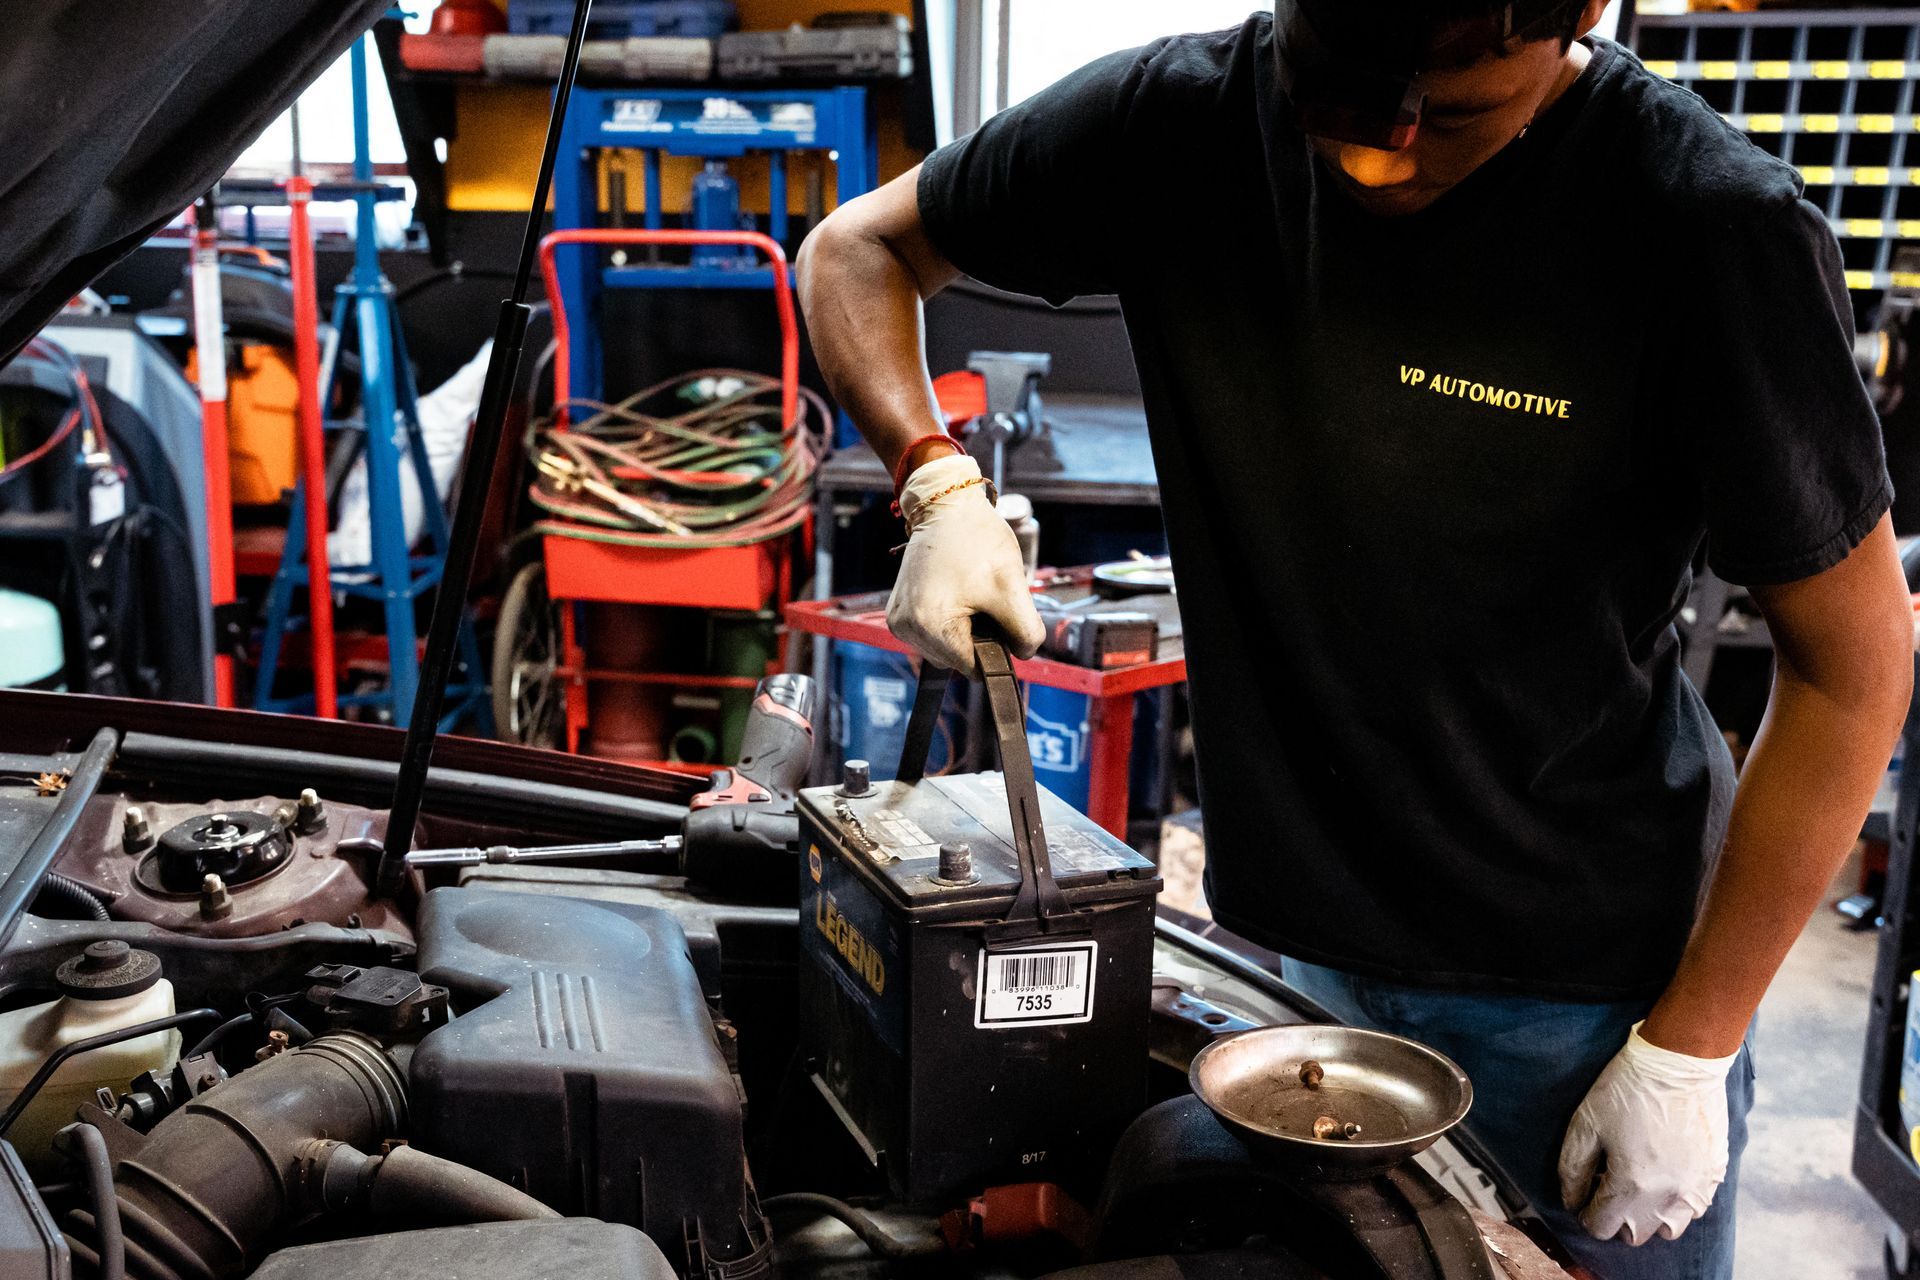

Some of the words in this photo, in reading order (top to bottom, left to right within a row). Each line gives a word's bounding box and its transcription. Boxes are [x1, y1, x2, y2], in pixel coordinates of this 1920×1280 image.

[1400, 365, 1425, 386] VP
[1429, 374, 1572, 419] AUTOMOTIVE
[816, 891, 885, 997] LEGEND
[1016, 994, 1052, 1012] 7535
[1022, 1150, 1047, 1165] 8/17
